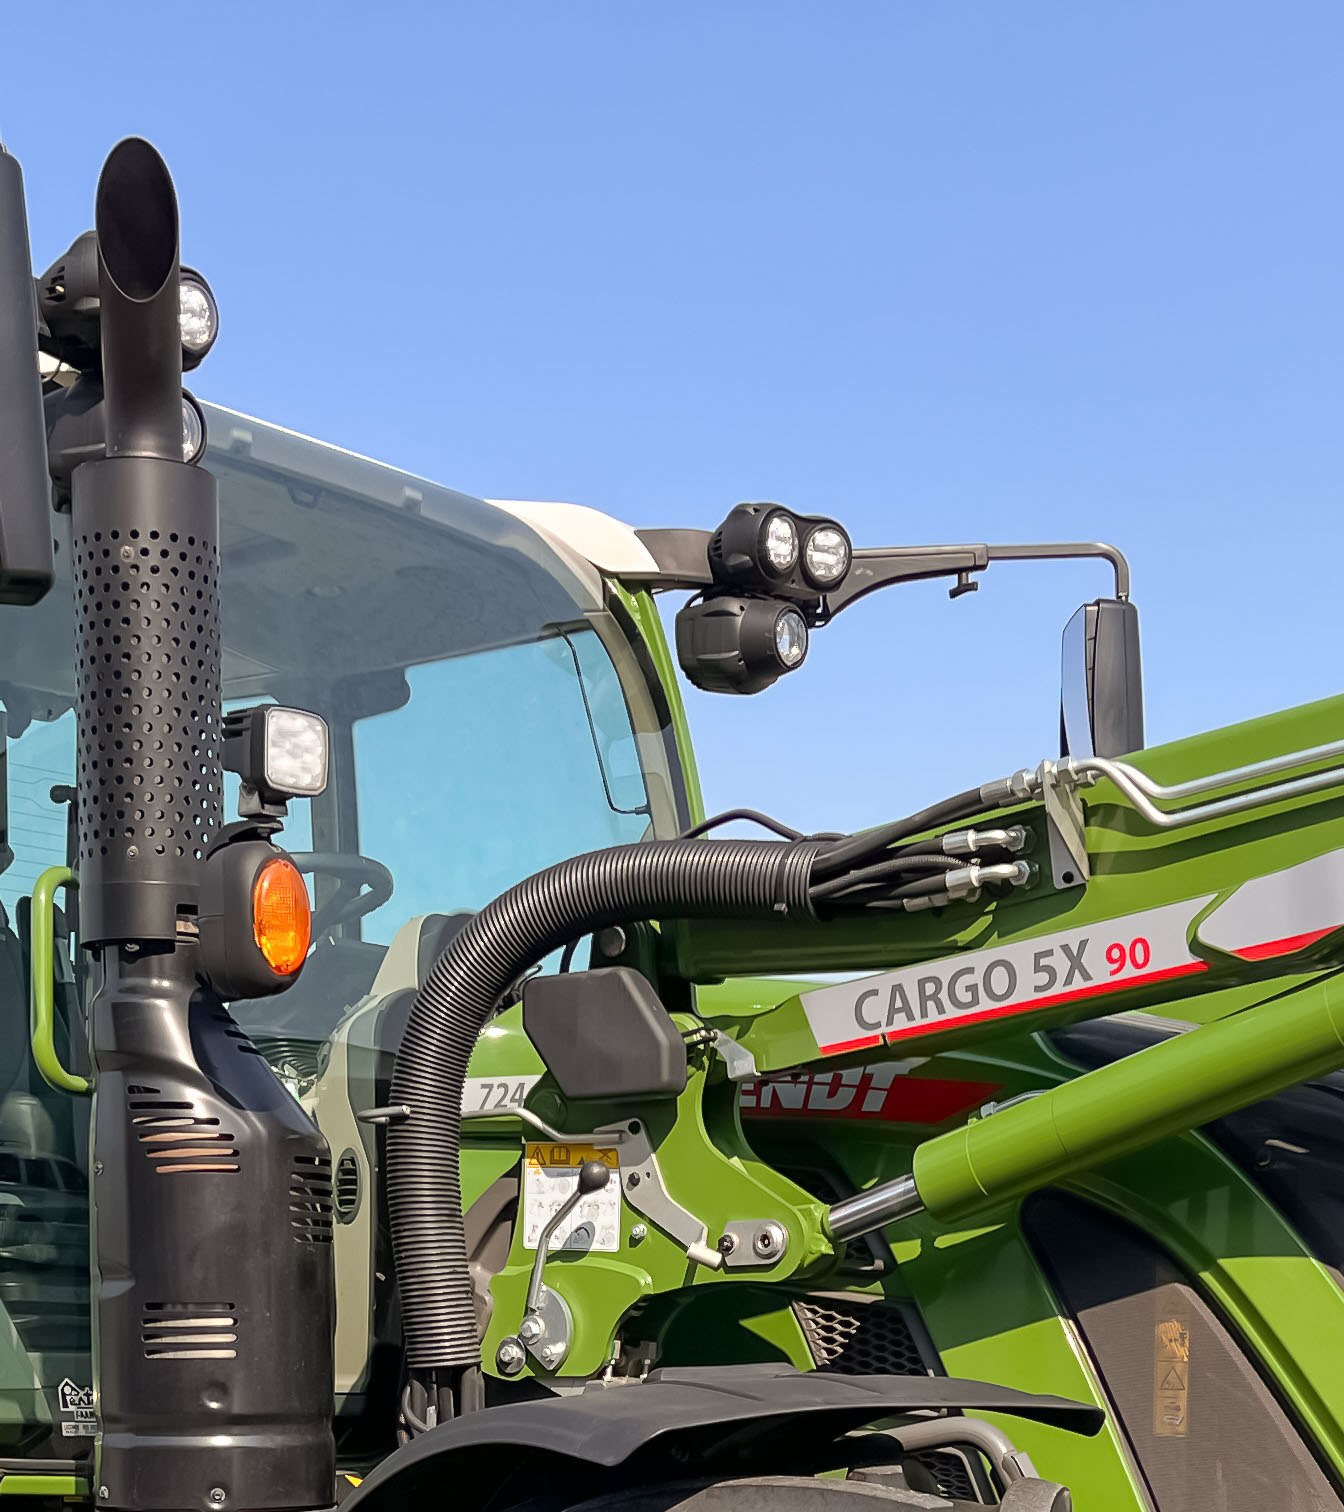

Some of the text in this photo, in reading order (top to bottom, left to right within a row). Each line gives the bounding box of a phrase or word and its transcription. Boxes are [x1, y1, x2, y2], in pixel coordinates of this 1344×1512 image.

[854, 936, 1151, 1032] CARGO 5X 90
[479, 1082, 526, 1111] 724
[739, 1058, 912, 1112] ENDT
